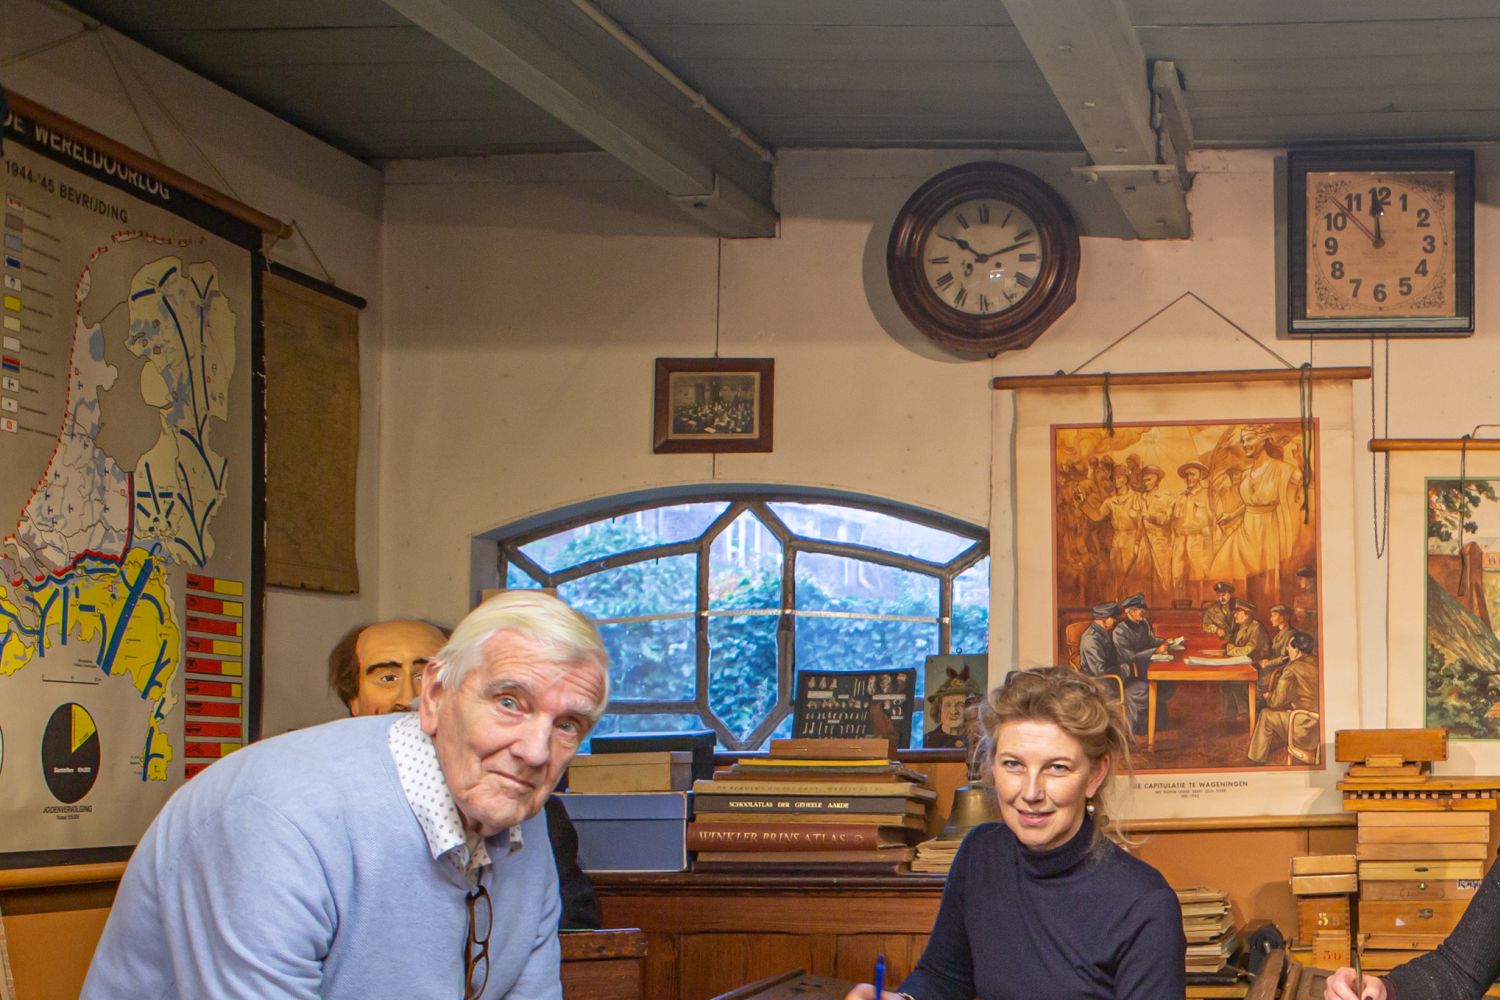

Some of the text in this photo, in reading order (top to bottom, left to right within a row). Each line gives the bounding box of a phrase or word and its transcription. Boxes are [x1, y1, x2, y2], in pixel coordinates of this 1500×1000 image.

[35, 124, 170, 200] WERELDOORLOG
[59, 184, 128, 224] BEVRIJDING
[1344, 193, 1362, 212] 11
[1400, 193, 1408, 212] 1
[1324, 212, 1347, 231] 10
[1416, 208, 1430, 228] 2
[1324, 237, 1338, 256] 9
[1422, 235, 1436, 254] 3
[1331, 261, 1344, 280] 8
[1414, 259, 1428, 277] 4
[1349, 279, 1362, 298] 7
[1373, 283, 1387, 302] 6
[1399, 277, 1412, 296] 5
[1199, 780, 1248, 789] WAGENINGEN
[699, 831, 758, 843] WINKLER
[805, 833, 846, 843] ATLAS
[1318, 912, 1329, 926] 5
